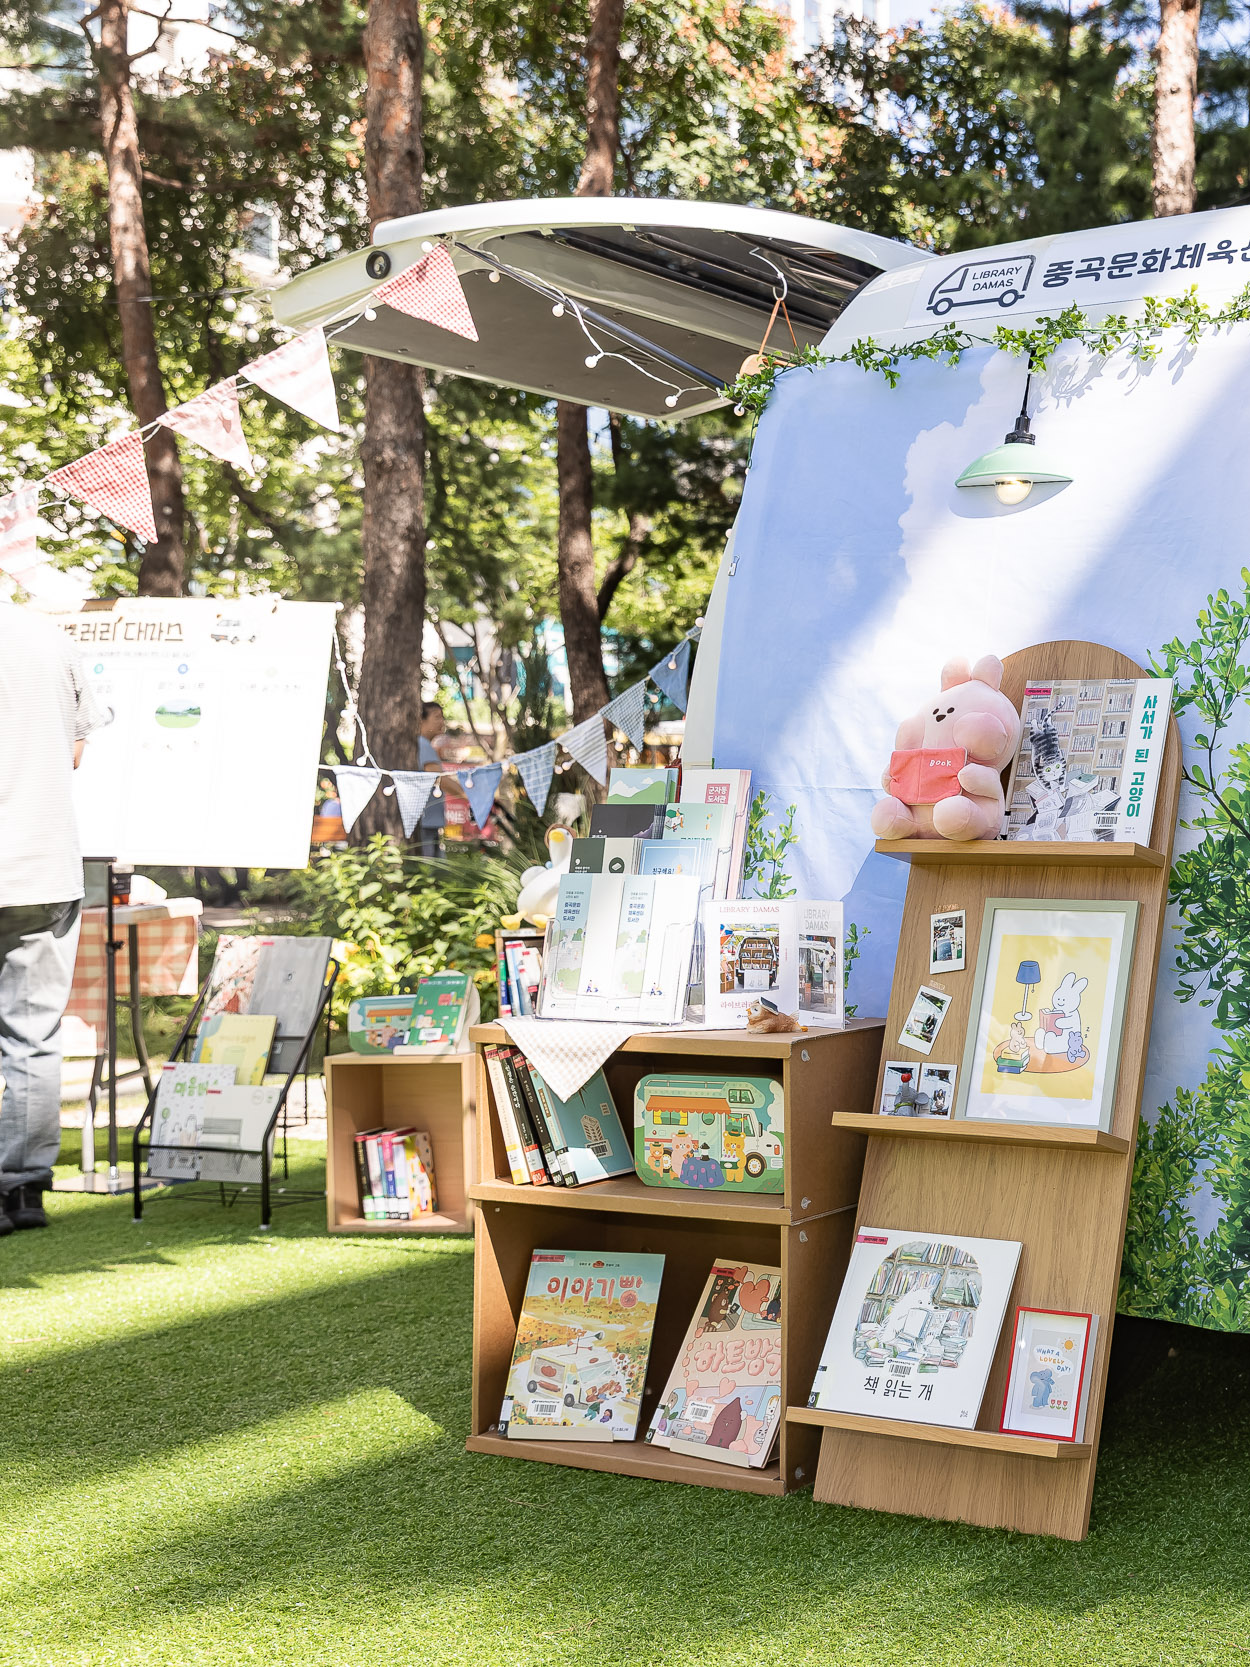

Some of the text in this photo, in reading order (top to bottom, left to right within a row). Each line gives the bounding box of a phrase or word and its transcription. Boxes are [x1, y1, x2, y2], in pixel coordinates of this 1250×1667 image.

[972, 265, 1023, 280] LIBRARY
[972, 278, 1014, 291] DAMAS
[1140, 695, 1158, 740] 사서가
[1134, 748, 1150, 764] 된
[1126, 772, 1146, 818] 고양이
[864, 1375, 934, 1400] 책 읽는 개
